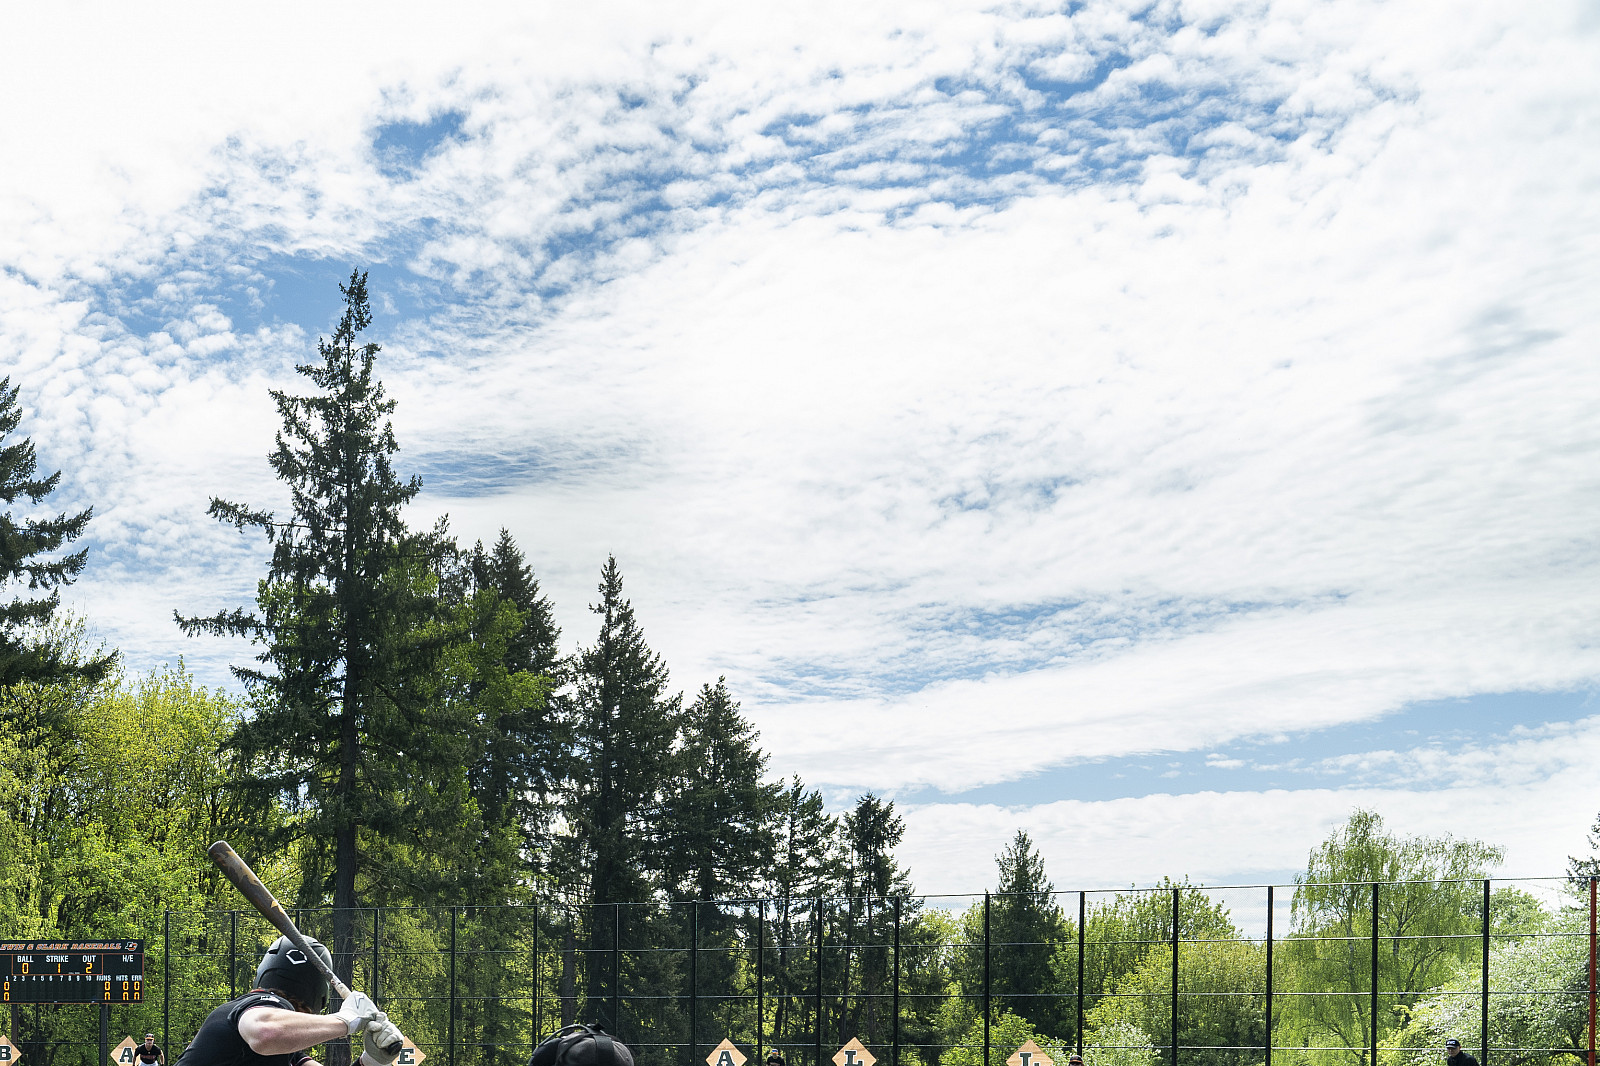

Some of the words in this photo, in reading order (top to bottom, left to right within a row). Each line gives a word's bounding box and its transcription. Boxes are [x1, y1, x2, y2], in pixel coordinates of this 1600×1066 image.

[70, 942, 122, 950] BASEBALL
[22, 963, 28, 974] 0
[85, 962, 92, 974] 2
[4, 981, 10, 991] 0
[104, 981, 110, 991] 0
[123, 981, 129, 991] 0
[134, 981, 140, 991] 0
[4, 992, 10, 1001] 0
[118, 1046, 135, 1064] A
[397, 1047, 415, 1066] E
